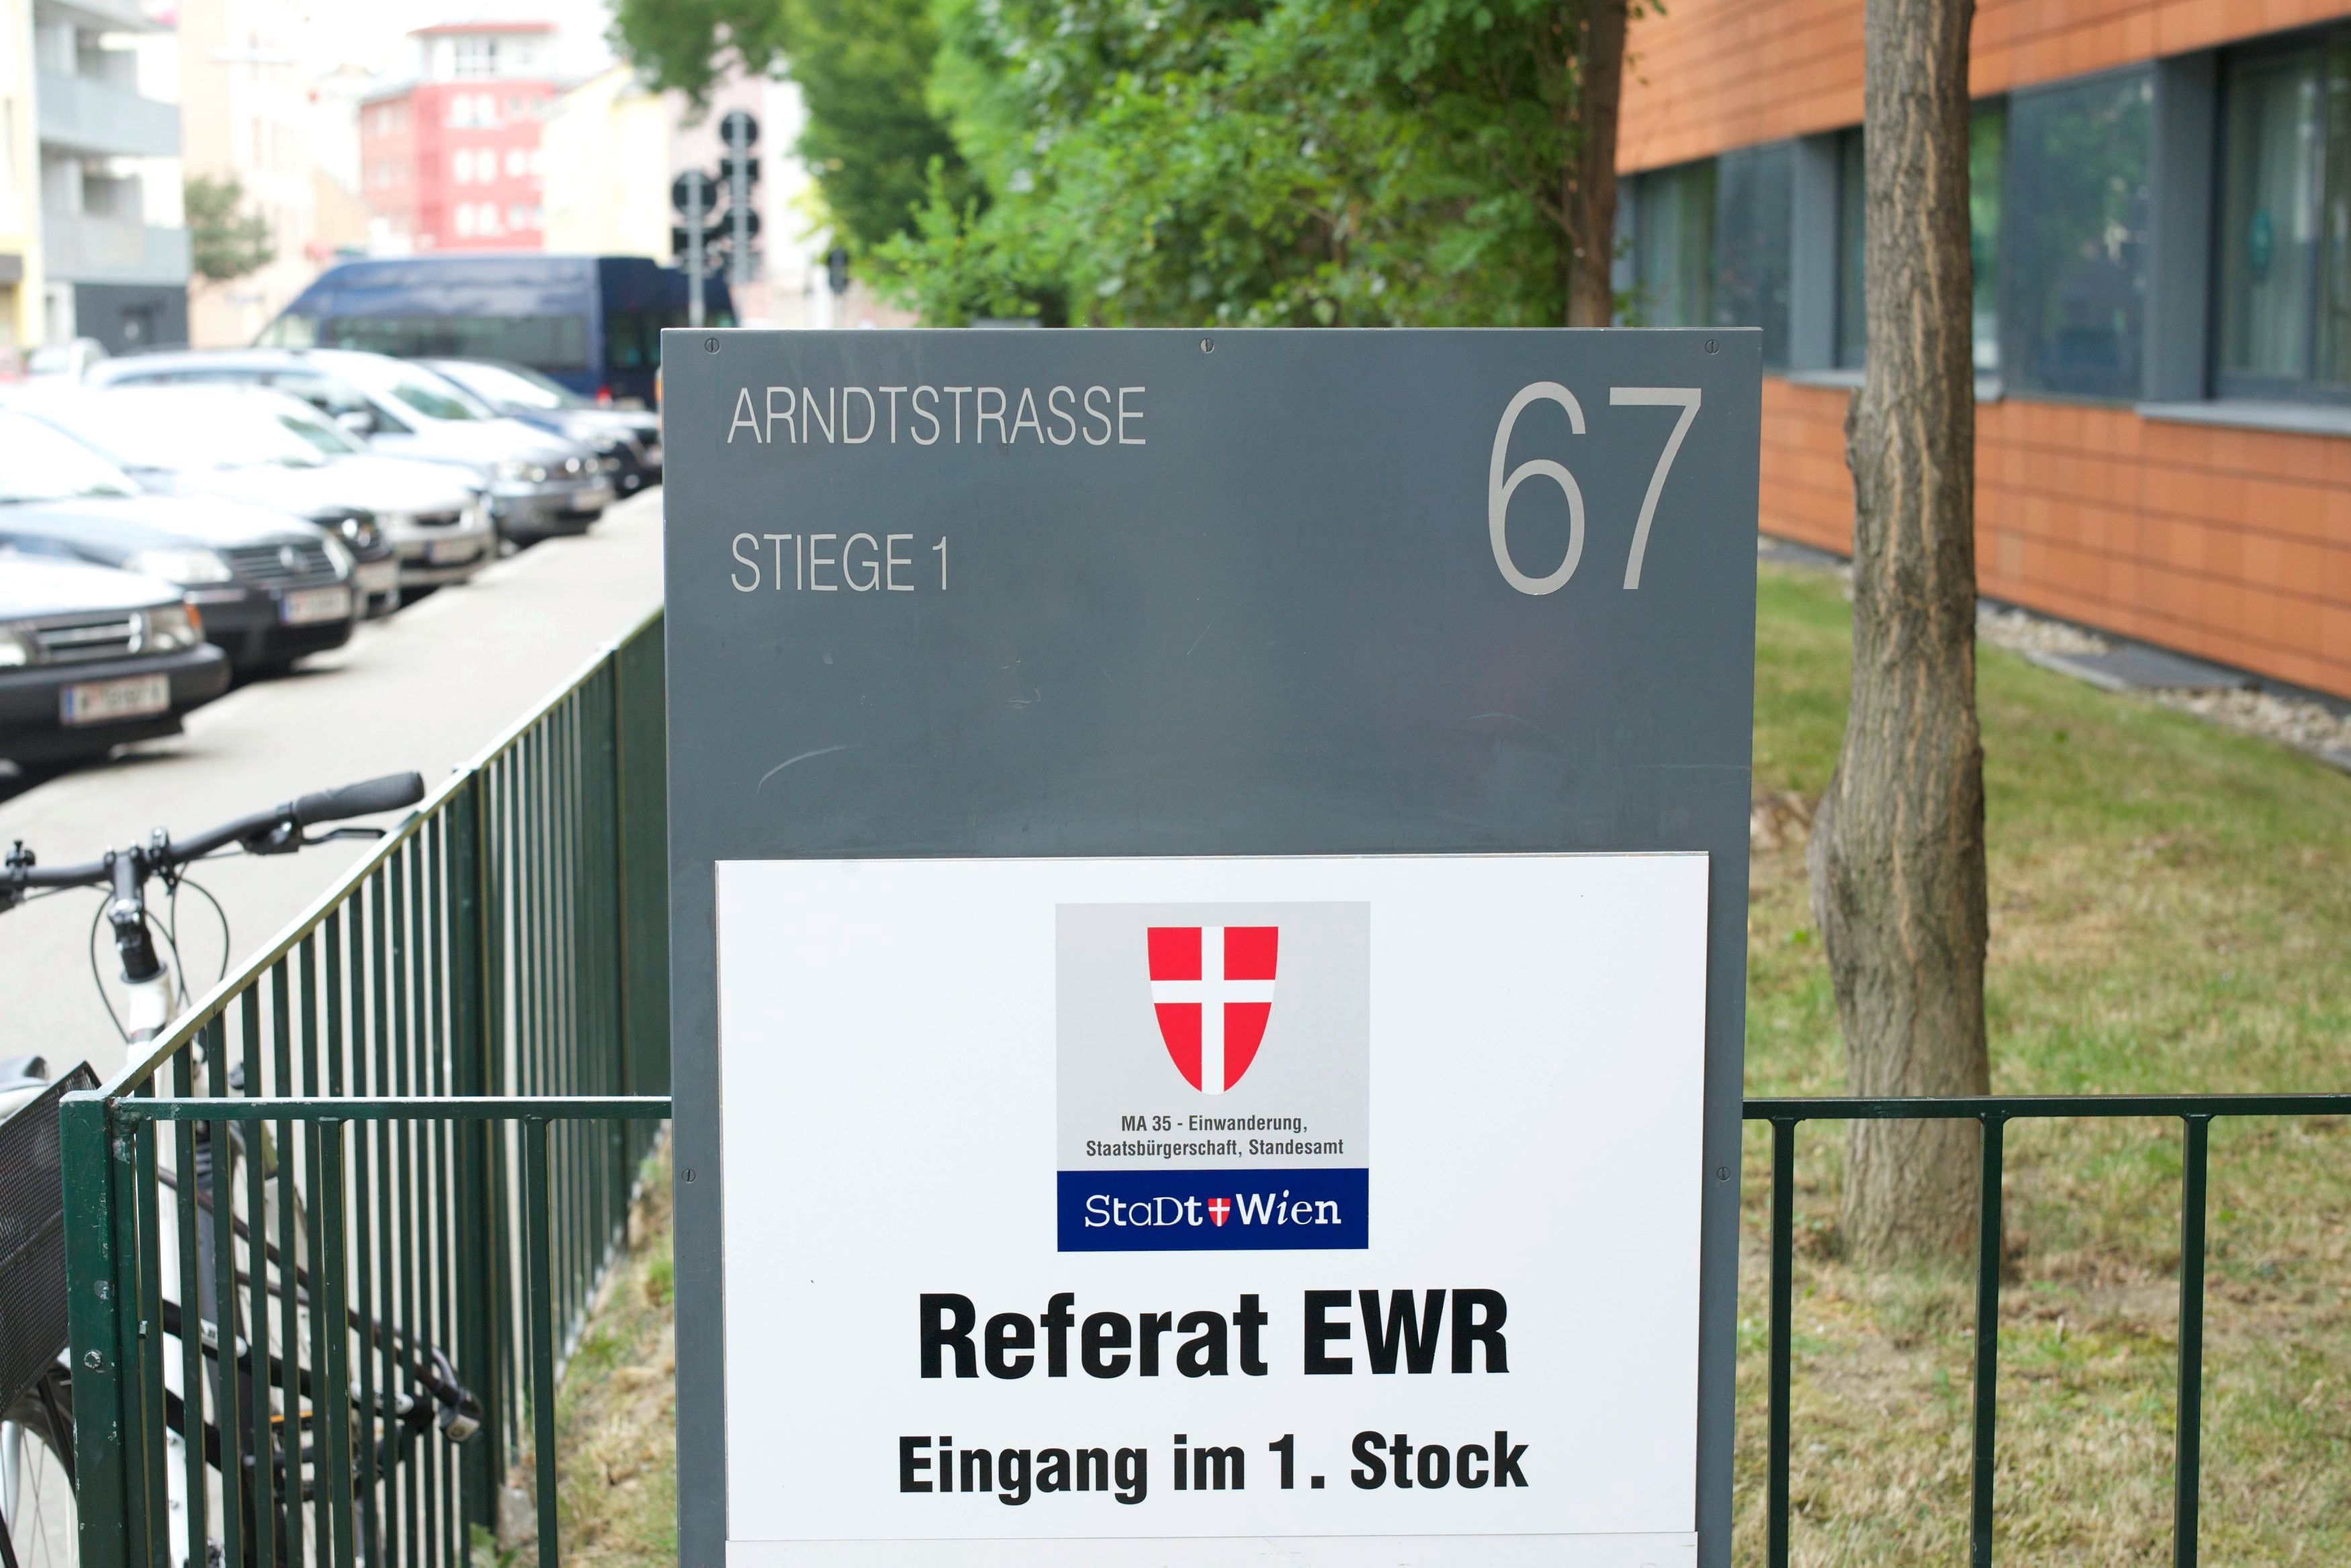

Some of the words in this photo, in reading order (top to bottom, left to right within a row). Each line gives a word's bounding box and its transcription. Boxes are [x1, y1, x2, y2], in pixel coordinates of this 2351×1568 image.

[727, 385, 1146, 446] ARNDTSTRASSE
[1488, 381, 1702, 596] 67
[731, 533, 915, 592] STIEGE
[932, 536, 948, 590] 1
[1086, 1139, 1243, 1160] Staatsbürgerschaft,
[1249, 1138, 1344, 1155] Standesamt
[1121, 1115, 1147, 1132] MA
[1152, 1115, 1171, 1132] 35
[1189, 1115, 1308, 1134] Einwanderung,
[1235, 1189, 1342, 1225] Wien
[920, 1292, 1268, 1380] Referat
[1304, 1288, 1510, 1375] EWR
[899, 1436, 1147, 1506] Eingang
[1173, 1434, 1245, 1491] im
[1269, 1434, 1325, 1489] 1.
[1351, 1430, 1529, 1490] Stock
